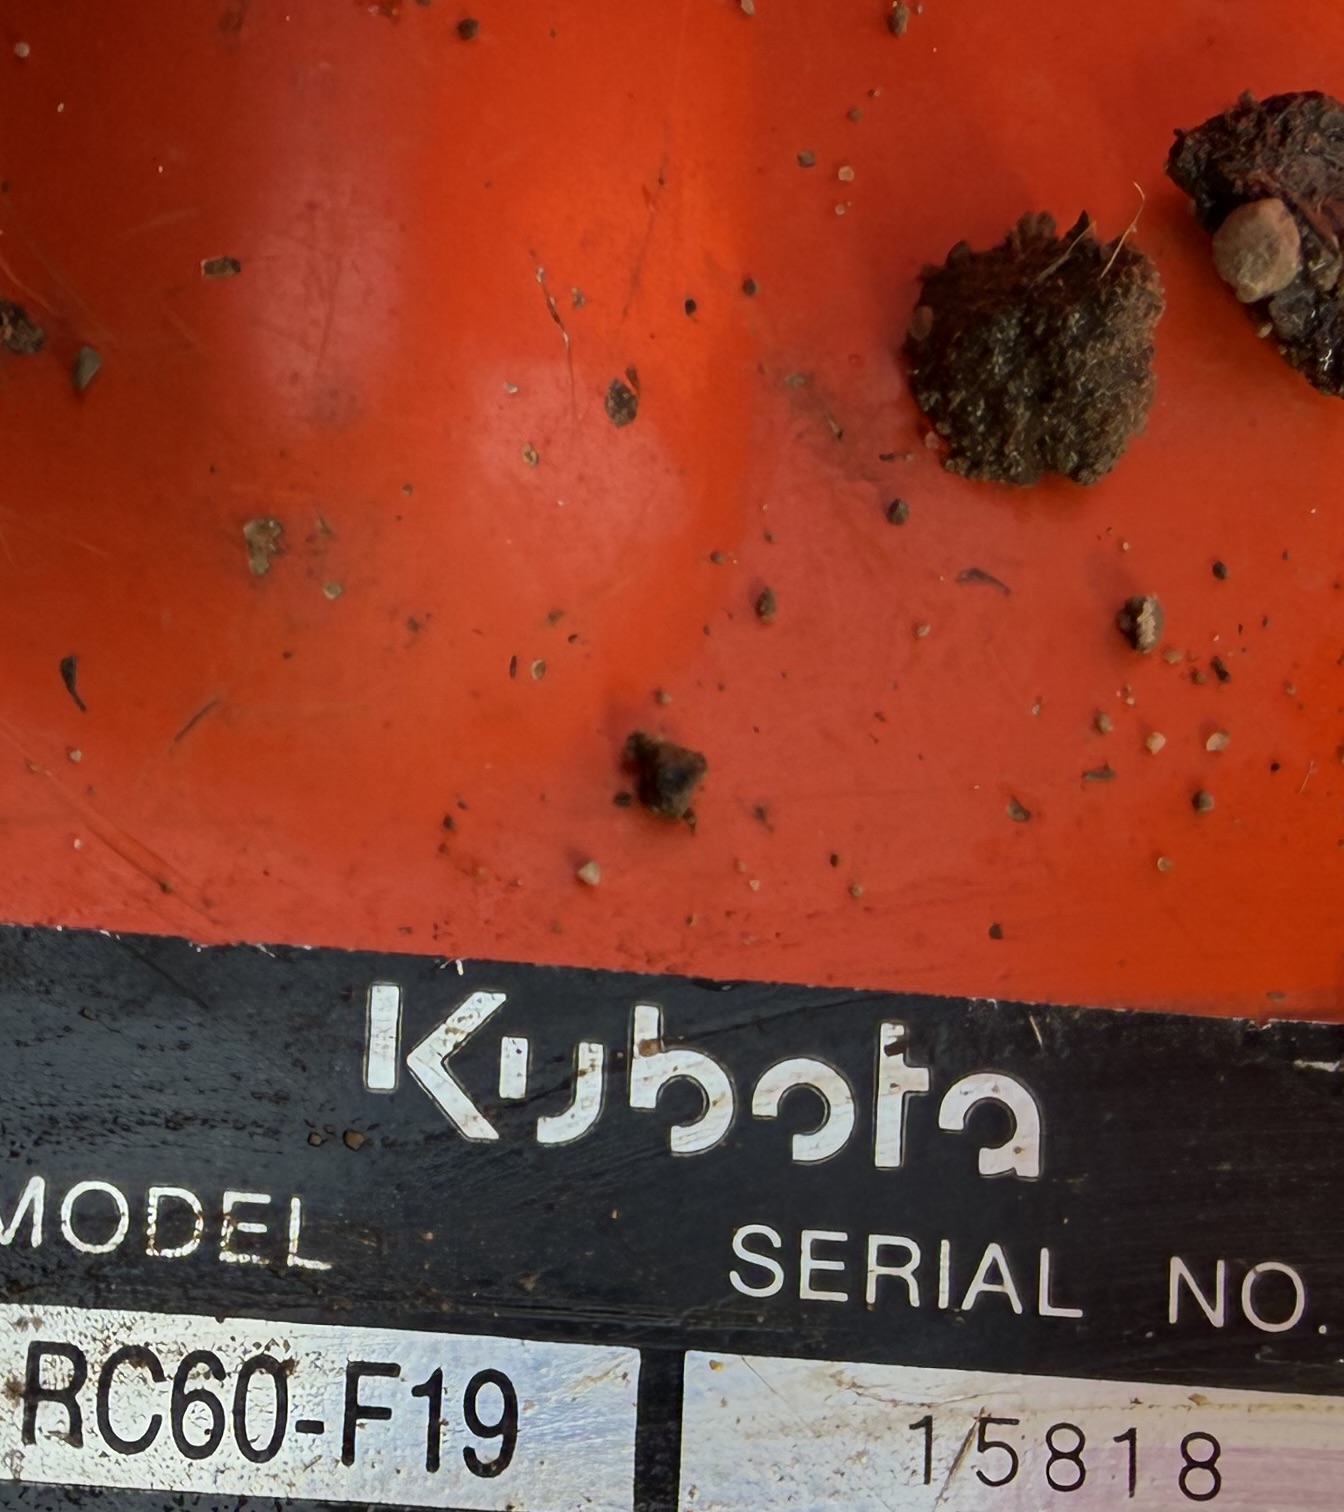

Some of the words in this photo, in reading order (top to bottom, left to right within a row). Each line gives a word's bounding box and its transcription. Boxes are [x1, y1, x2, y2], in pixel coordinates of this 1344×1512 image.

[364, 981, 1044, 1182] Kubota
[729, 1223, 1084, 1320] SERIAL
[1168, 1256, 1330, 1335] NO.
[20, 1339, 521, 1479] RC60-F19
[907, 1414, 1224, 1503] 15818
